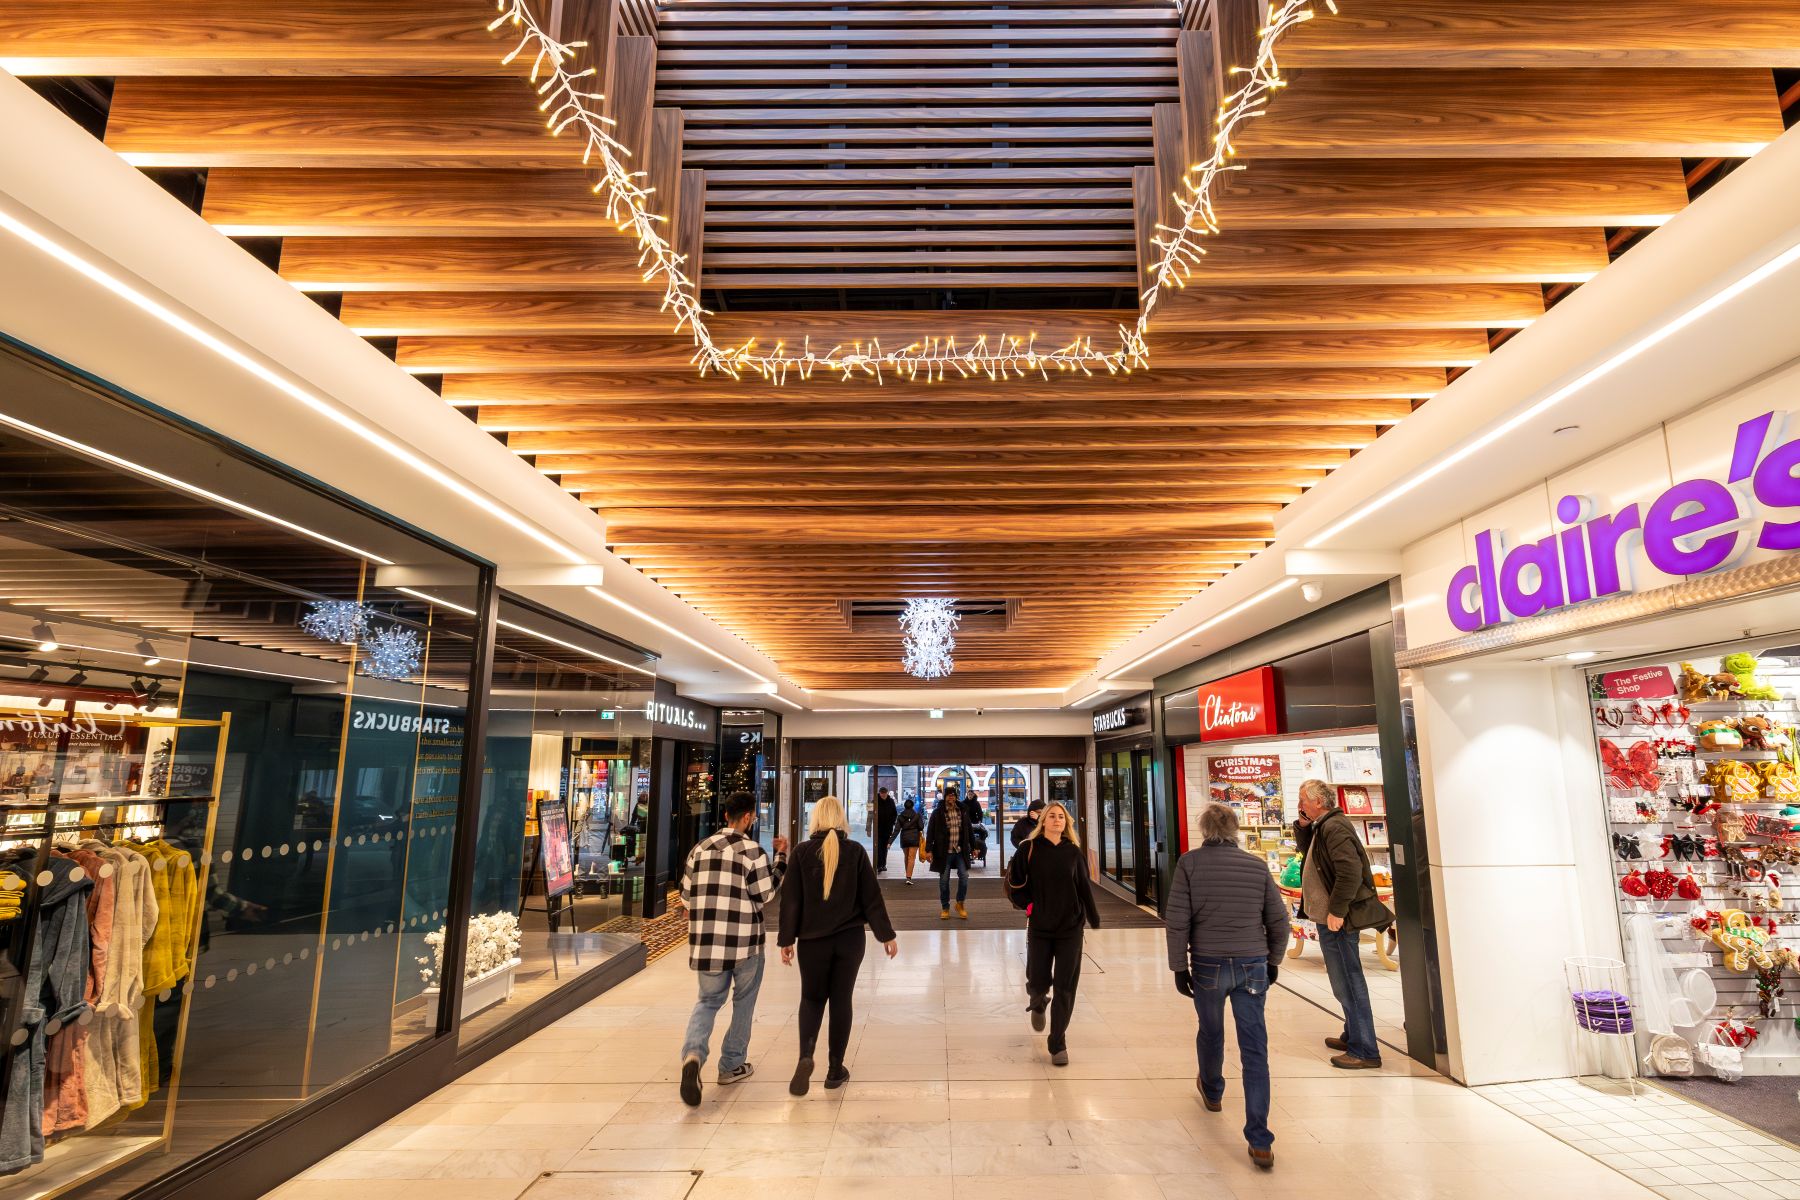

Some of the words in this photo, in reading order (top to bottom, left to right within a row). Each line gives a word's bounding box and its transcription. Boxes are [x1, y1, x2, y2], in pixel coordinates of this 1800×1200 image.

[1613, 678, 1631, 686] The
[1632, 670, 1663, 682] Festive
[1616, 684, 1640, 694] Shop
[1204, 694, 1257, 731] Clintons
[1093, 707, 1126, 733] STARBUCKS
[27, 731, 60, 740] LUXUR
[70, 732, 123, 742] ESSENTIALS
[1214, 757, 1273, 769] CHRISTMAS
[1227, 766, 1261, 775] CARDS
